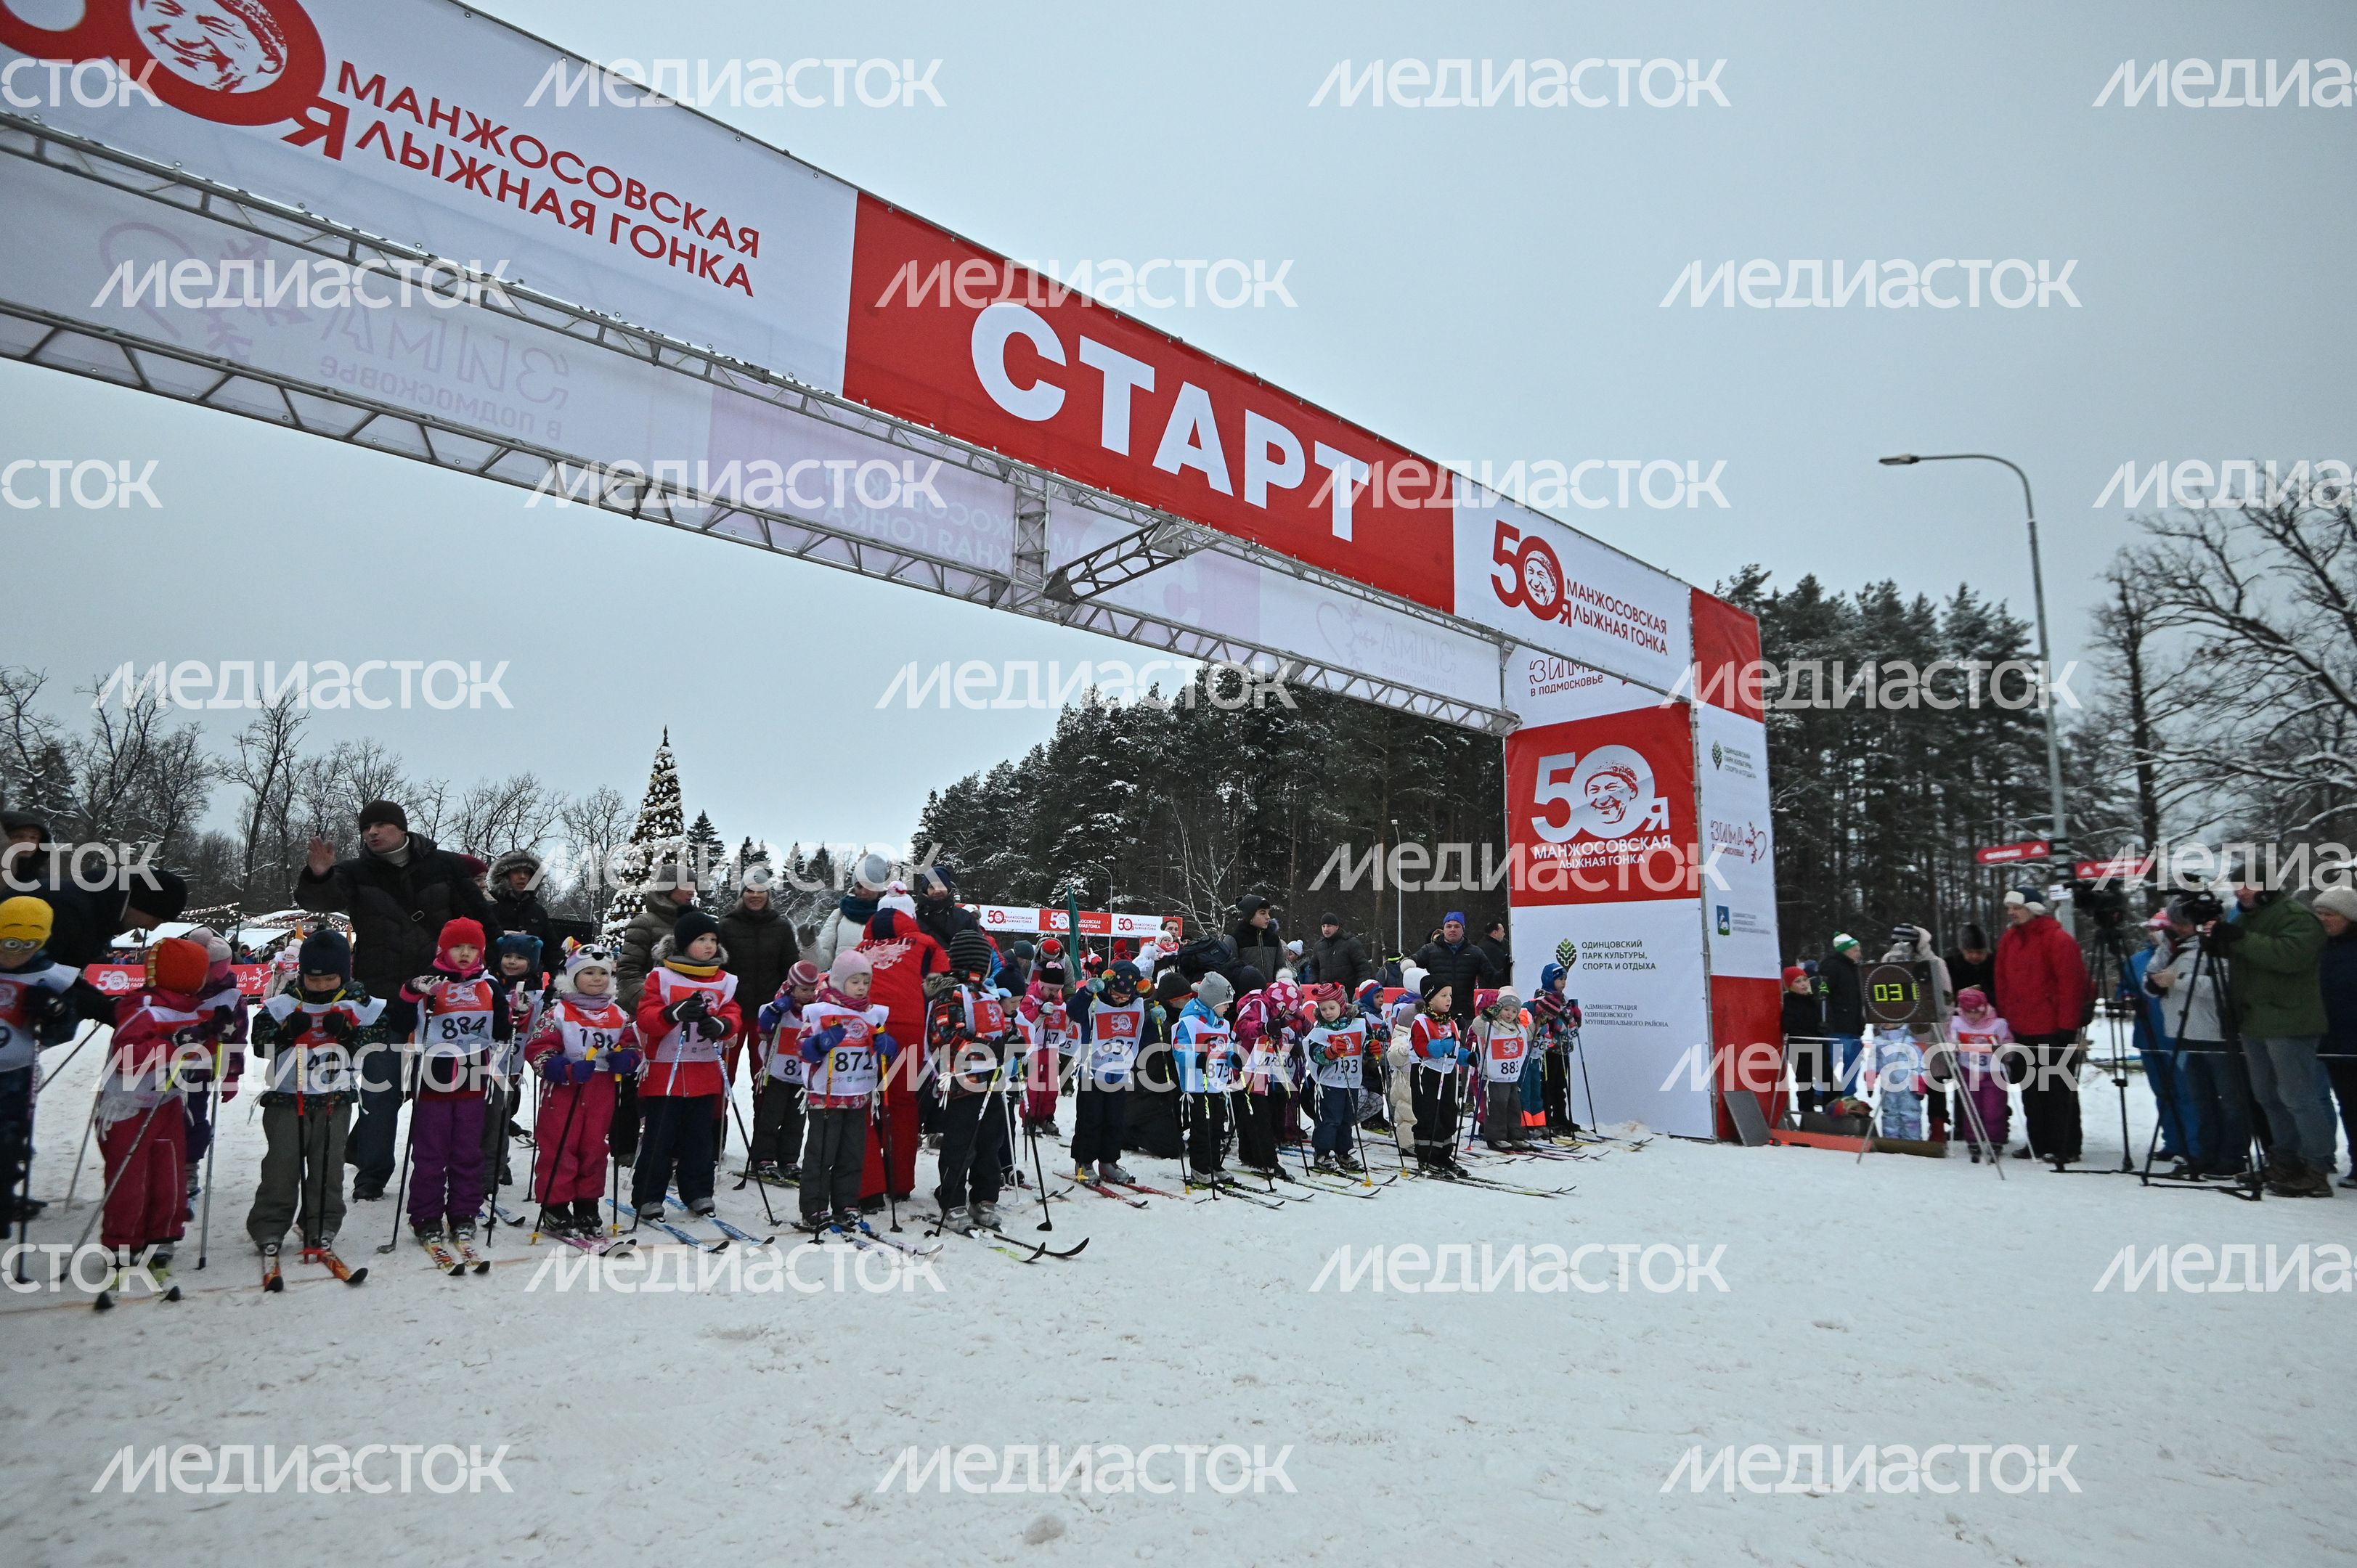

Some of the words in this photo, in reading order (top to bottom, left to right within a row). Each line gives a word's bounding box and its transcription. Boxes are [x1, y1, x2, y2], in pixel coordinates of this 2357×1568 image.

[337, 60, 760, 258] МАНЖОСОВСКАЯ
[356, 121, 596, 236] ЛЫЖНАЯ
[609, 213, 754, 297] ГОНКА
[970, 301, 1370, 542] СТАРТ
[1567, 579, 1667, 635] МАНЖОСОВСКАЯ
[1574, 605, 1628, 640] ЛЫЖНАЯ
[1631, 626, 1668, 656] ГОНКА
[1529, 657, 1596, 684] ЗИМ
[1534, 835, 1671, 859] МАНЖОСОВСКАЯ
[1558, 856, 1605, 869] ЛЫЖНАЯ
[1608, 853, 1645, 865] ГОНКА
[1581, 939, 1642, 950] ОДИНЦОВСКИЙ
[1622, 963, 1656, 971] ОТДЫХА
[441, 1016, 487, 1040] 884
[1102, 1039, 1133, 1056] 637
[834, 1050, 874, 1071] 872
